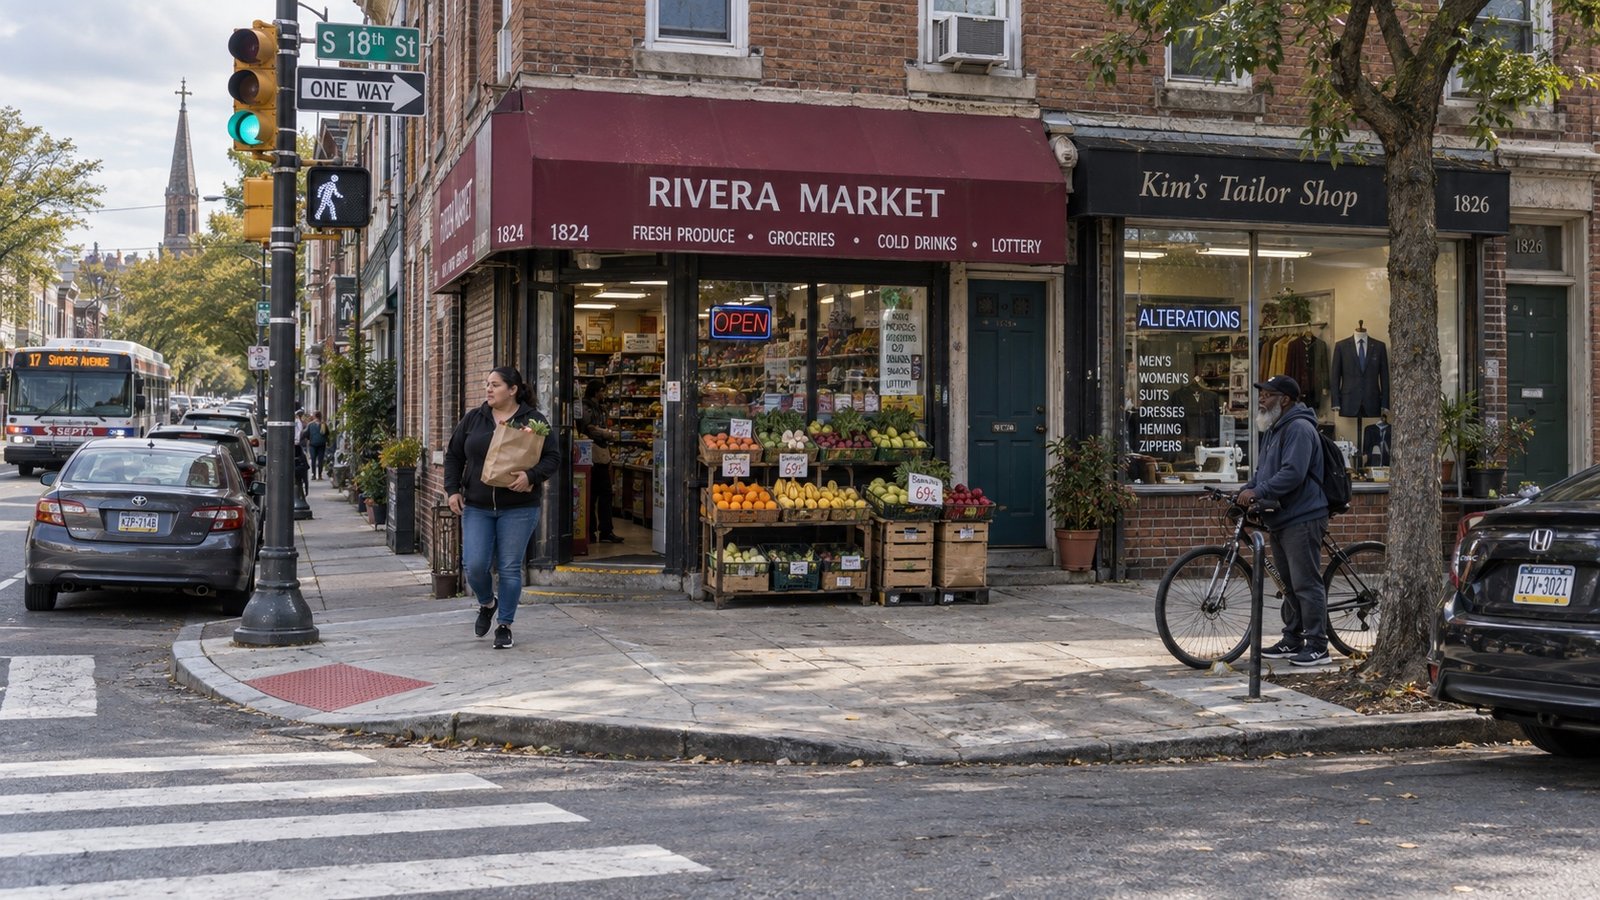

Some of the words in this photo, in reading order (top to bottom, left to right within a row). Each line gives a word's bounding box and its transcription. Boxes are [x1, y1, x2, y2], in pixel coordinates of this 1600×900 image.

[322, 31, 336, 54] S
[347, 30, 385, 55] 18th
[394, 35, 416, 58] St
[310, 80, 348, 98] ONE
[357, 82, 393, 100] WAY
[649, 176, 780, 212] RIVERA
[800, 183, 945, 218] MARKET
[1139, 171, 1208, 200] Kim's
[1219, 175, 1291, 204] Tailor
[1300, 179, 1358, 216] Shop
[1453, 194, 1490, 213] 1826
[497, 224, 524, 243] 1824
[550, 223, 590, 241] 1824
[632, 225, 672, 241] FRESH
[677, 227, 736, 244] PRODUCE
[768, 230, 835, 247] GROCERIES
[877, 234, 910, 250] COLD
[914, 235, 957, 251] DRINKS
[991, 237, 1042, 254] LOTTERY
[1516, 239, 1543, 254] 1826
[714, 312, 768, 333] OPEN
[1138, 308, 1240, 329] ALTERATIONS
[29, 353, 42, 367] 17
[1139, 355, 1172, 367] MEN'S
[1139, 372, 1189, 384] WOMEN'S
[1139, 389, 1170, 401] SUITS
[1139, 406, 1185, 418] DRESSES
[56, 426, 94, 436] SEPTA
[1139, 423, 1182, 435] HEMING
[1139, 440, 1182, 452] ZIPPERS
